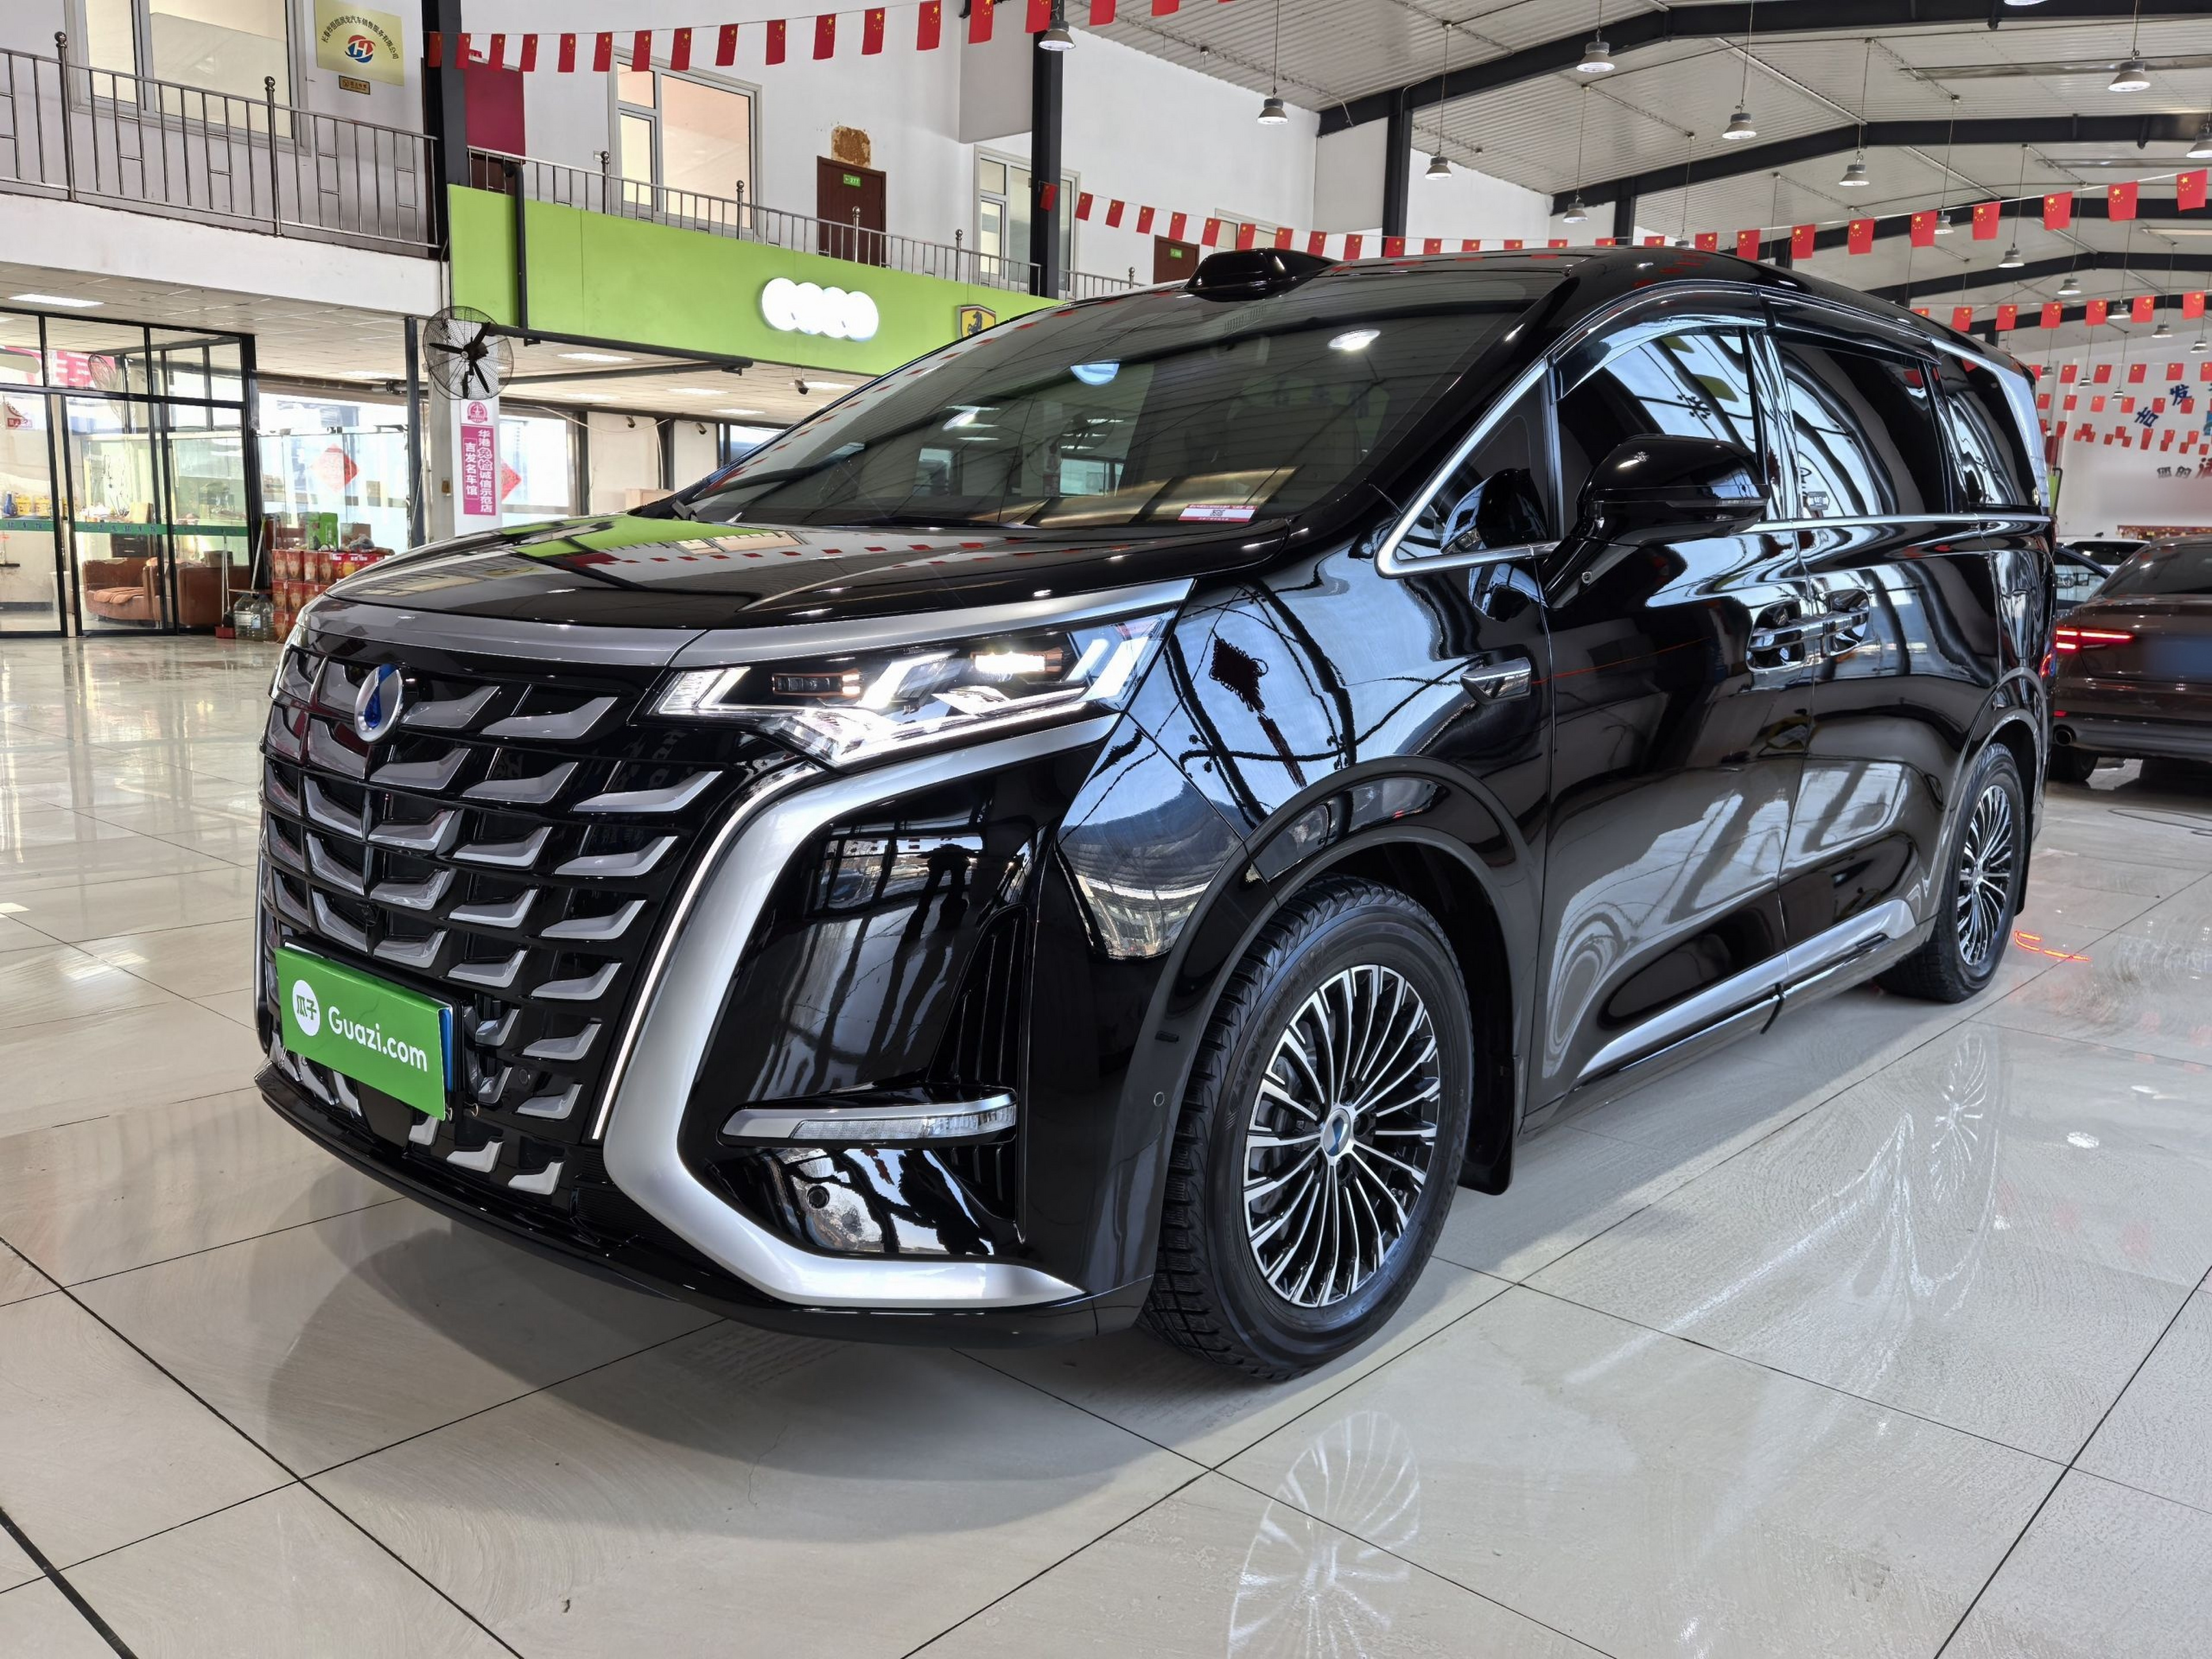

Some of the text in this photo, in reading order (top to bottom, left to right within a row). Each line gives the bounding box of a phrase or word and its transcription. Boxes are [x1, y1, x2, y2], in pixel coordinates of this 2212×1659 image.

[464, 442, 478, 496] 吉发名车馆
[478, 429, 493, 513] 华港免检诚信示范店
[296, 995, 317, 1021] 瓜子
[328, 1006, 427, 1072] Guazi.com
